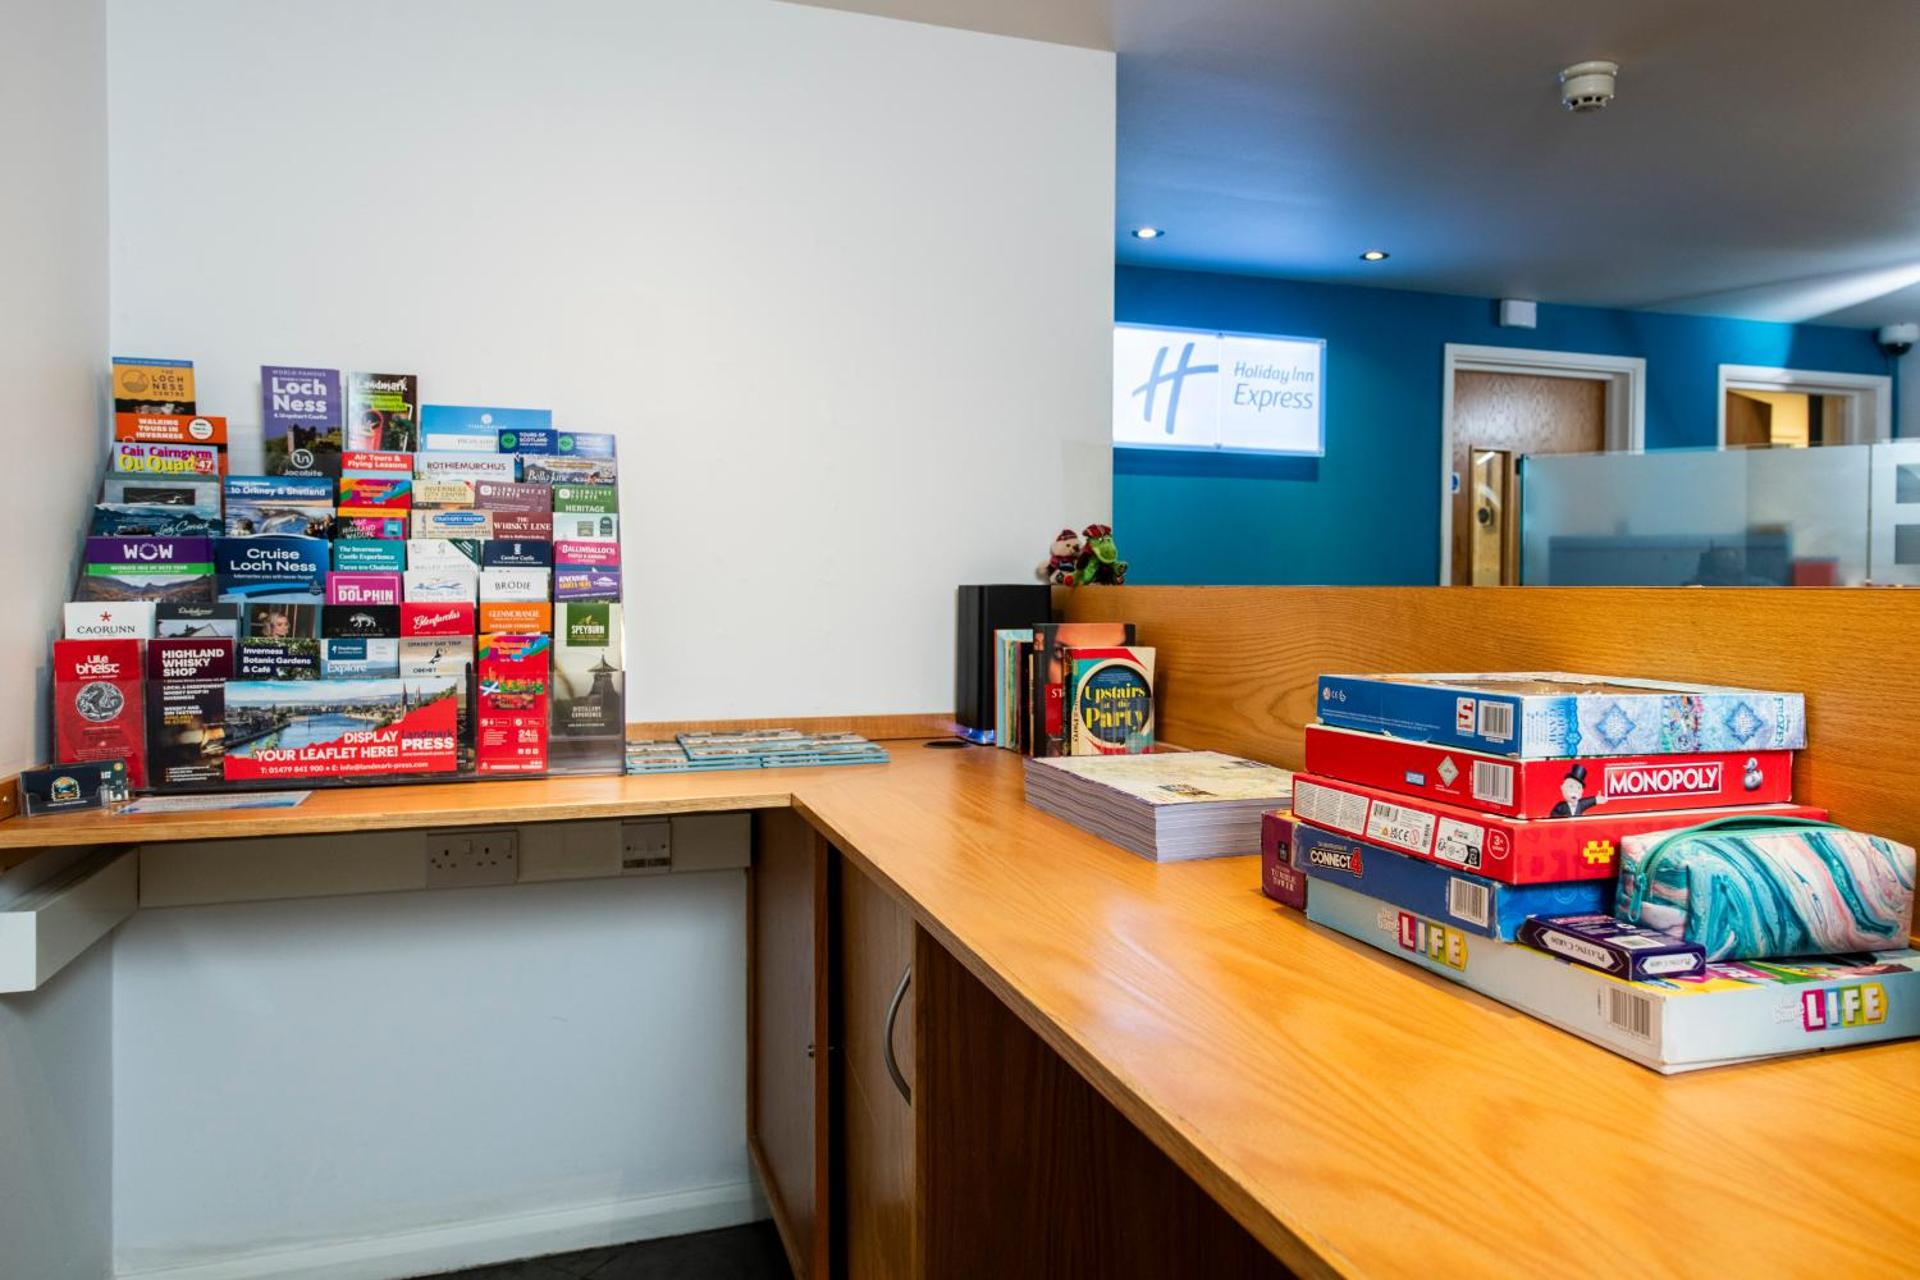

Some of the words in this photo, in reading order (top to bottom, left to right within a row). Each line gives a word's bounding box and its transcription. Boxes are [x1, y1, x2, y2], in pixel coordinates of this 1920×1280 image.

[1233, 361, 1290, 384] Holiday
[1291, 365, 1315, 383] Inn
[151, 375, 184, 383] LOCH
[152, 383, 185, 391] NESS
[272, 377, 327, 396] Loch
[1233, 383, 1314, 412] Express
[273, 395, 327, 413] Ness
[138, 418, 179, 426] WALKING
[168, 425, 179, 433] IN
[135, 432, 184, 440] INVERNESS
[149, 446, 212, 460] Cairngorm
[347, 460, 373, 468] Flying
[427, 461, 506, 470] ROTHIEMURCHUS
[283, 469, 323, 477] Jacobite
[230, 486, 242, 494] to
[243, 487, 276, 496] Orkney
[285, 488, 325, 496] Shetland
[565, 504, 605, 512] HERITAGE
[493, 522, 529, 531] WHISKY
[530, 522, 552, 531] LINE
[123, 542, 174, 560] WOW
[246, 548, 300, 559] Cruise
[562, 544, 616, 555] BALLINDALLOCH
[230, 560, 273, 571] Loch
[276, 560, 317, 572] Ness
[494, 581, 531, 590] BRODIE
[338, 590, 394, 602] DOLPHIN
[77, 625, 136, 634] CAORUNN
[571, 624, 605, 635] SPEYBURN
[162, 648, 225, 659] HIGHLAND
[243, 647, 284, 655] Inverness
[162, 658, 211, 668] WHISKY
[243, 656, 275, 664] Botanic
[275, 657, 311, 665] Gardens
[162, 667, 197, 677] SHOP
[327, 663, 367, 674] Explore
[1084, 683, 1147, 704] Upstairs
[1102, 701, 1111, 709] at
[1117, 700, 1130, 708] the
[1085, 707, 1144, 730] Party
[1773, 697, 1784, 747] FROZEN
[343, 731, 398, 744] DISPLAY
[401, 737, 455, 750] PRESS
[255, 750, 297, 763] YOUR
[300, 747, 358, 760] LEAFLET
[360, 745, 398, 758] HERE!
[269, 766, 293, 774] 01479
[309, 764, 324, 772] 900
[340, 762, 429, 772] info@landmark-press.com
[1608, 766, 1719, 794] MONOPOLY
[1310, 849, 1351, 870] CONNECT
[1349, 847, 1364, 878] 4
[1401, 915, 1462, 965] LIFE
[1550, 935, 1575, 952] CARDS
[1574, 944, 1605, 963] PLAYING
[1805, 987, 1882, 1027] LIFE
